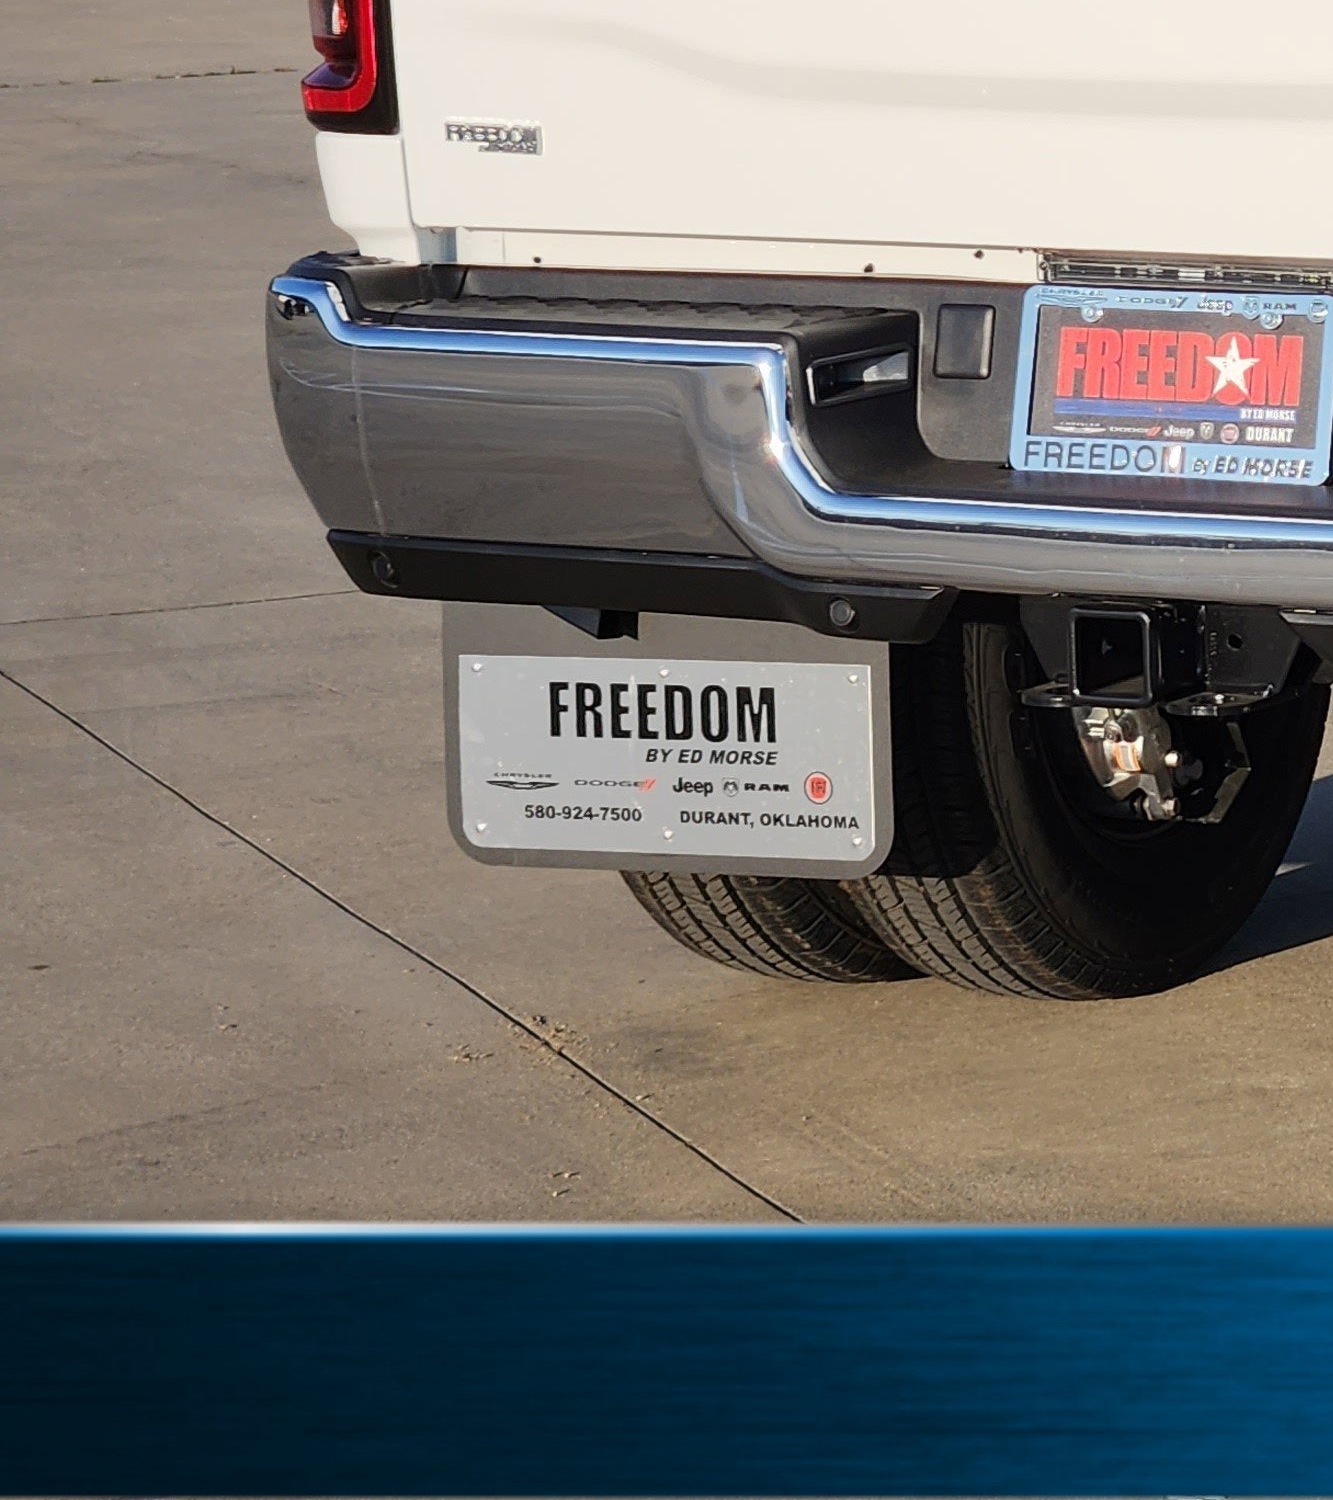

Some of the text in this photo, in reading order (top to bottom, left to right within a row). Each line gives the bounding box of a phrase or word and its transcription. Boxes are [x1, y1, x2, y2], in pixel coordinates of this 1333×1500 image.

[1262, 301, 1298, 311] RAM
[1056, 327, 1304, 406] FREEDOM
[1265, 409, 1297, 421] MORSE
[1163, 424, 1196, 440] Jeep
[1245, 426, 1295, 443] DURANT
[548, 681, 777, 744] FREEDOM
[645, 748, 779, 766] BY ED MORSE
[672, 777, 714, 798] Jeep
[743, 782, 790, 793] RAM
[524, 804, 860, 830] 580-924-7500 DURANT, OKLAHOMA
